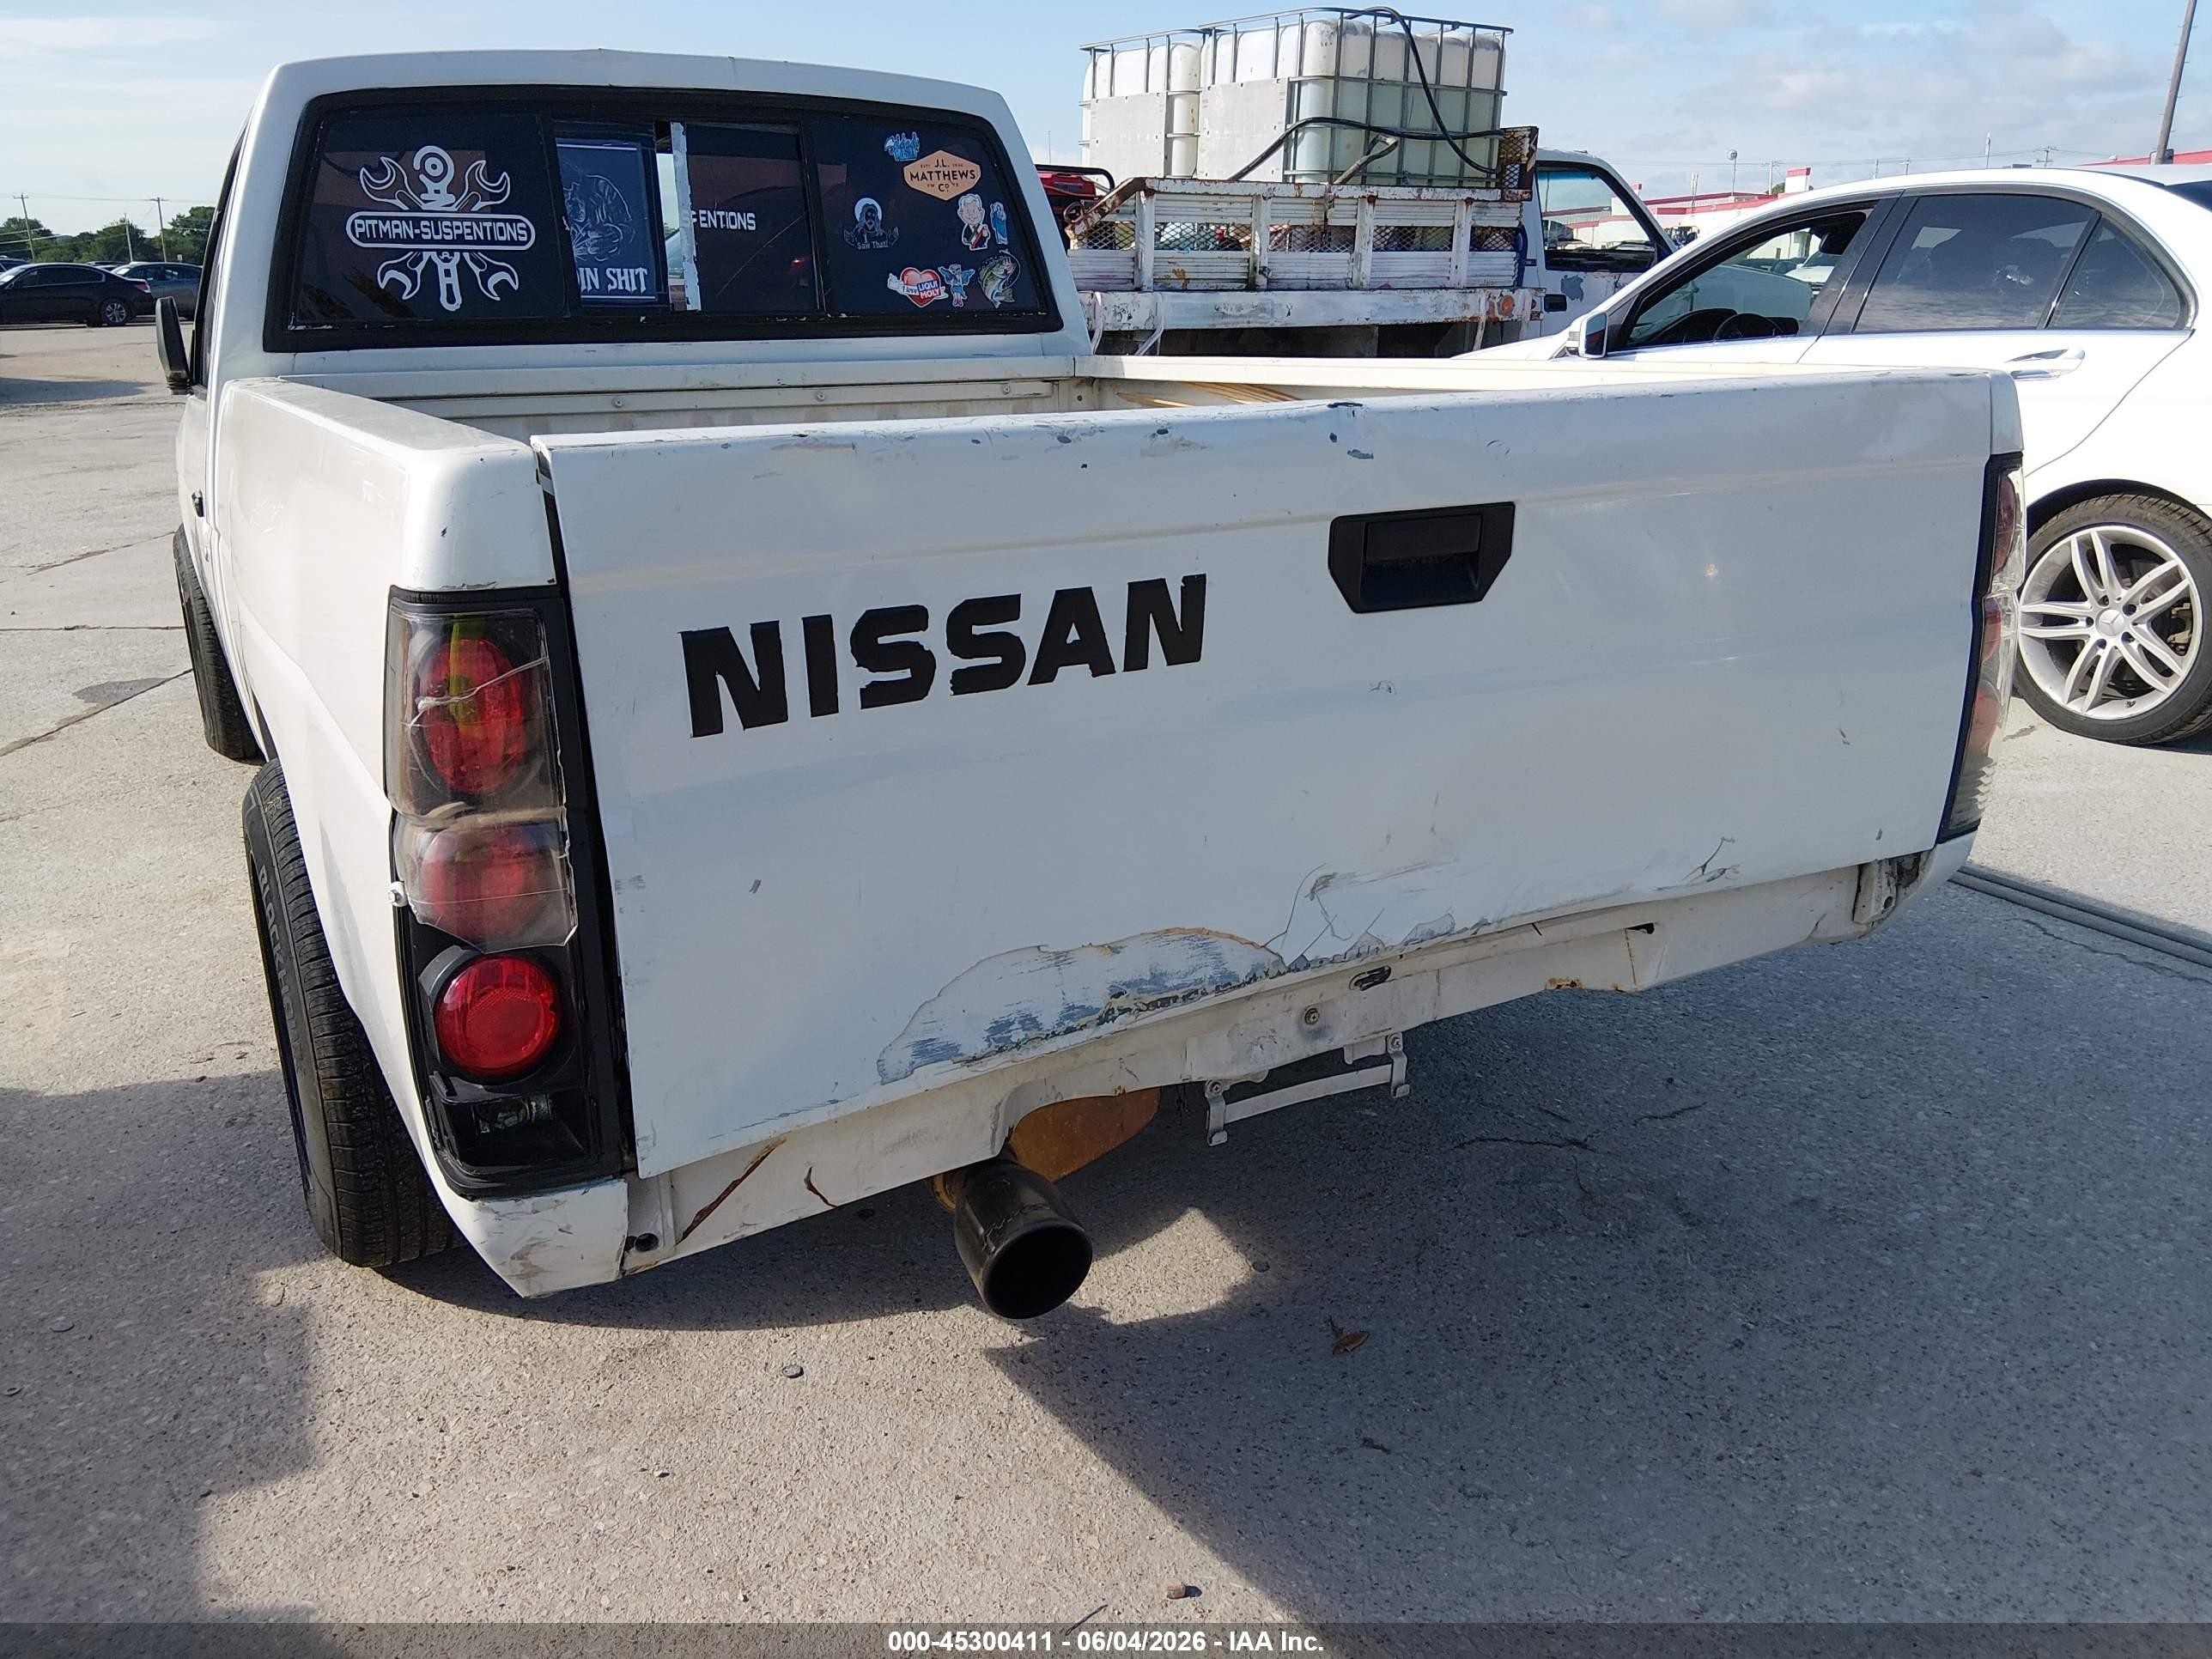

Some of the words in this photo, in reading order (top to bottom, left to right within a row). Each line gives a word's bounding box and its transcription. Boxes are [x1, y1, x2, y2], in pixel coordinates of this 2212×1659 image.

[910, 170, 975, 182] MATTHEWS
[354, 218, 528, 242] PITMAN-SUSPENTIONS
[577, 267, 600, 293] IN
[605, 266, 648, 294] SHIT
[918, 281, 939, 292] LIQUI
[920, 288, 940, 300] MOLY
[680, 573, 1206, 738] NISSAN
